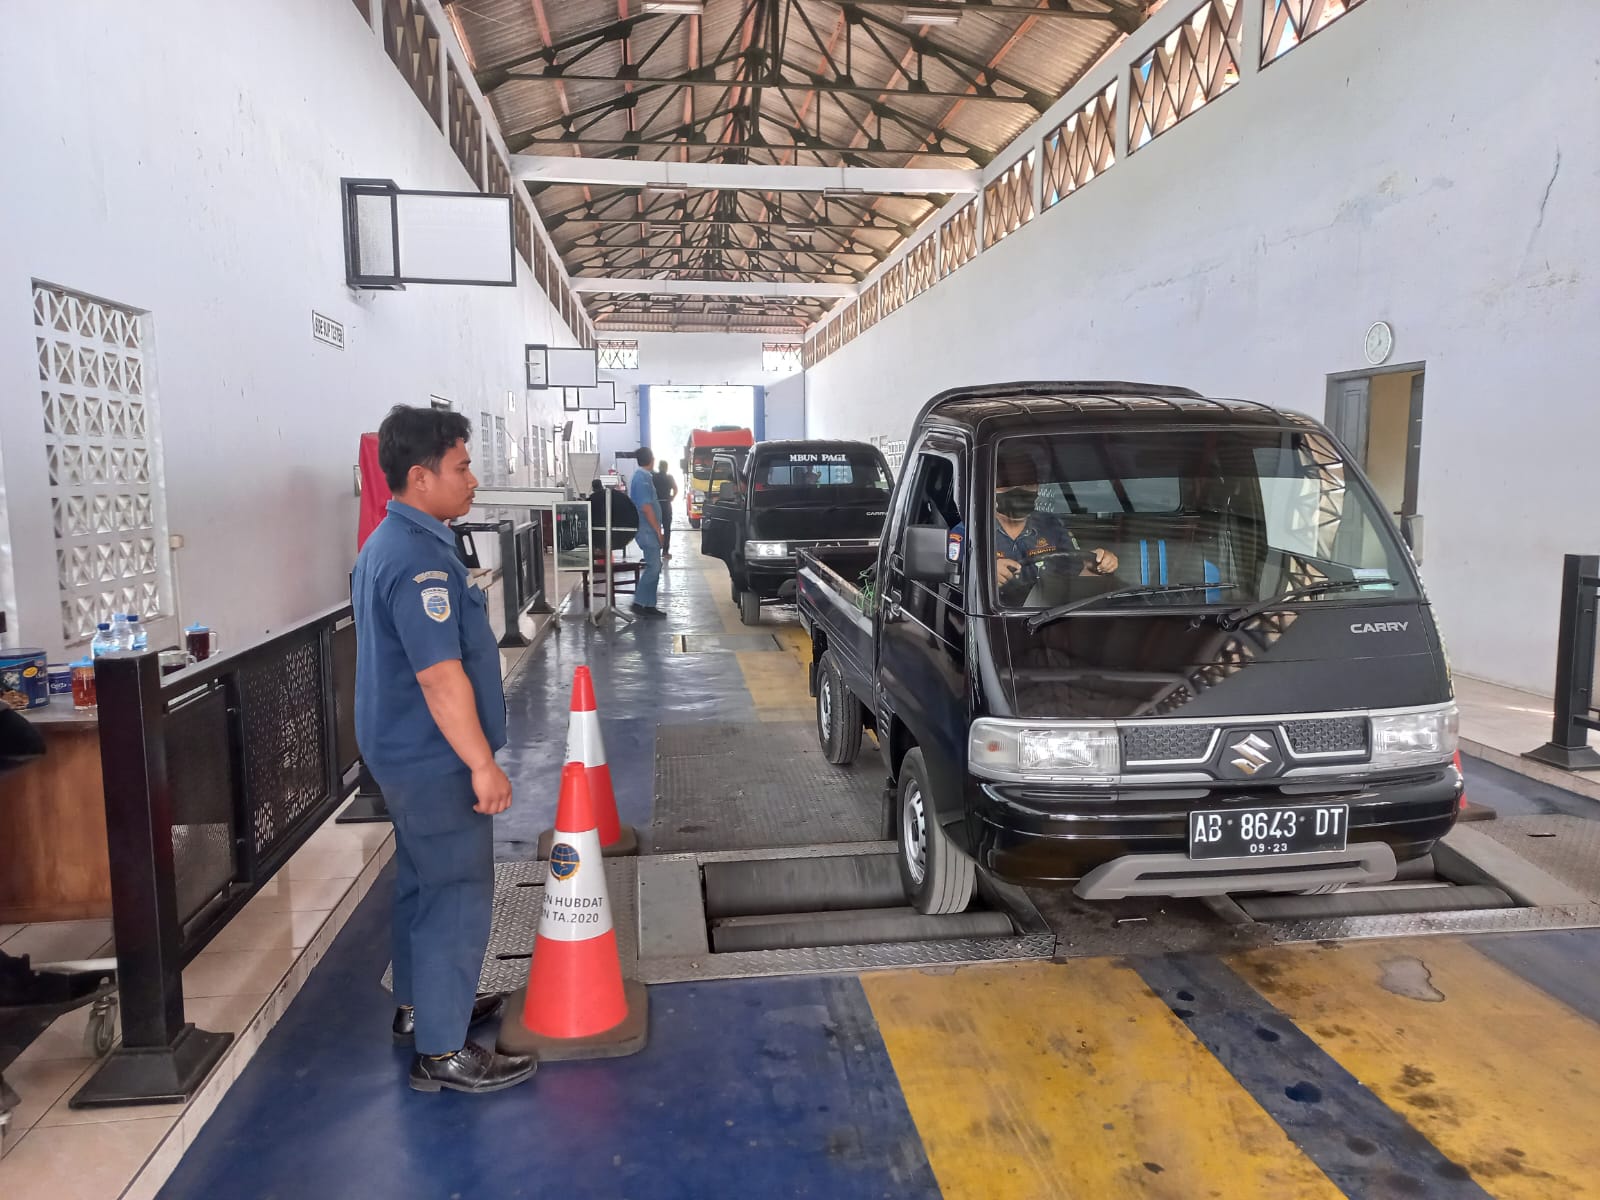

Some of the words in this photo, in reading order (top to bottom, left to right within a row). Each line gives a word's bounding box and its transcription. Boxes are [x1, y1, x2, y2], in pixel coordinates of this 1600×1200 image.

[821, 453, 847, 462] PAGI
[1350, 621, 1409, 634] CARRY
[1194, 814, 1222, 842] AB
[1240, 811, 1297, 840] 8643
[1315, 808, 1344, 836] DT
[555, 896, 604, 908] HUBDAT
[552, 911, 599, 923] TA.2020
